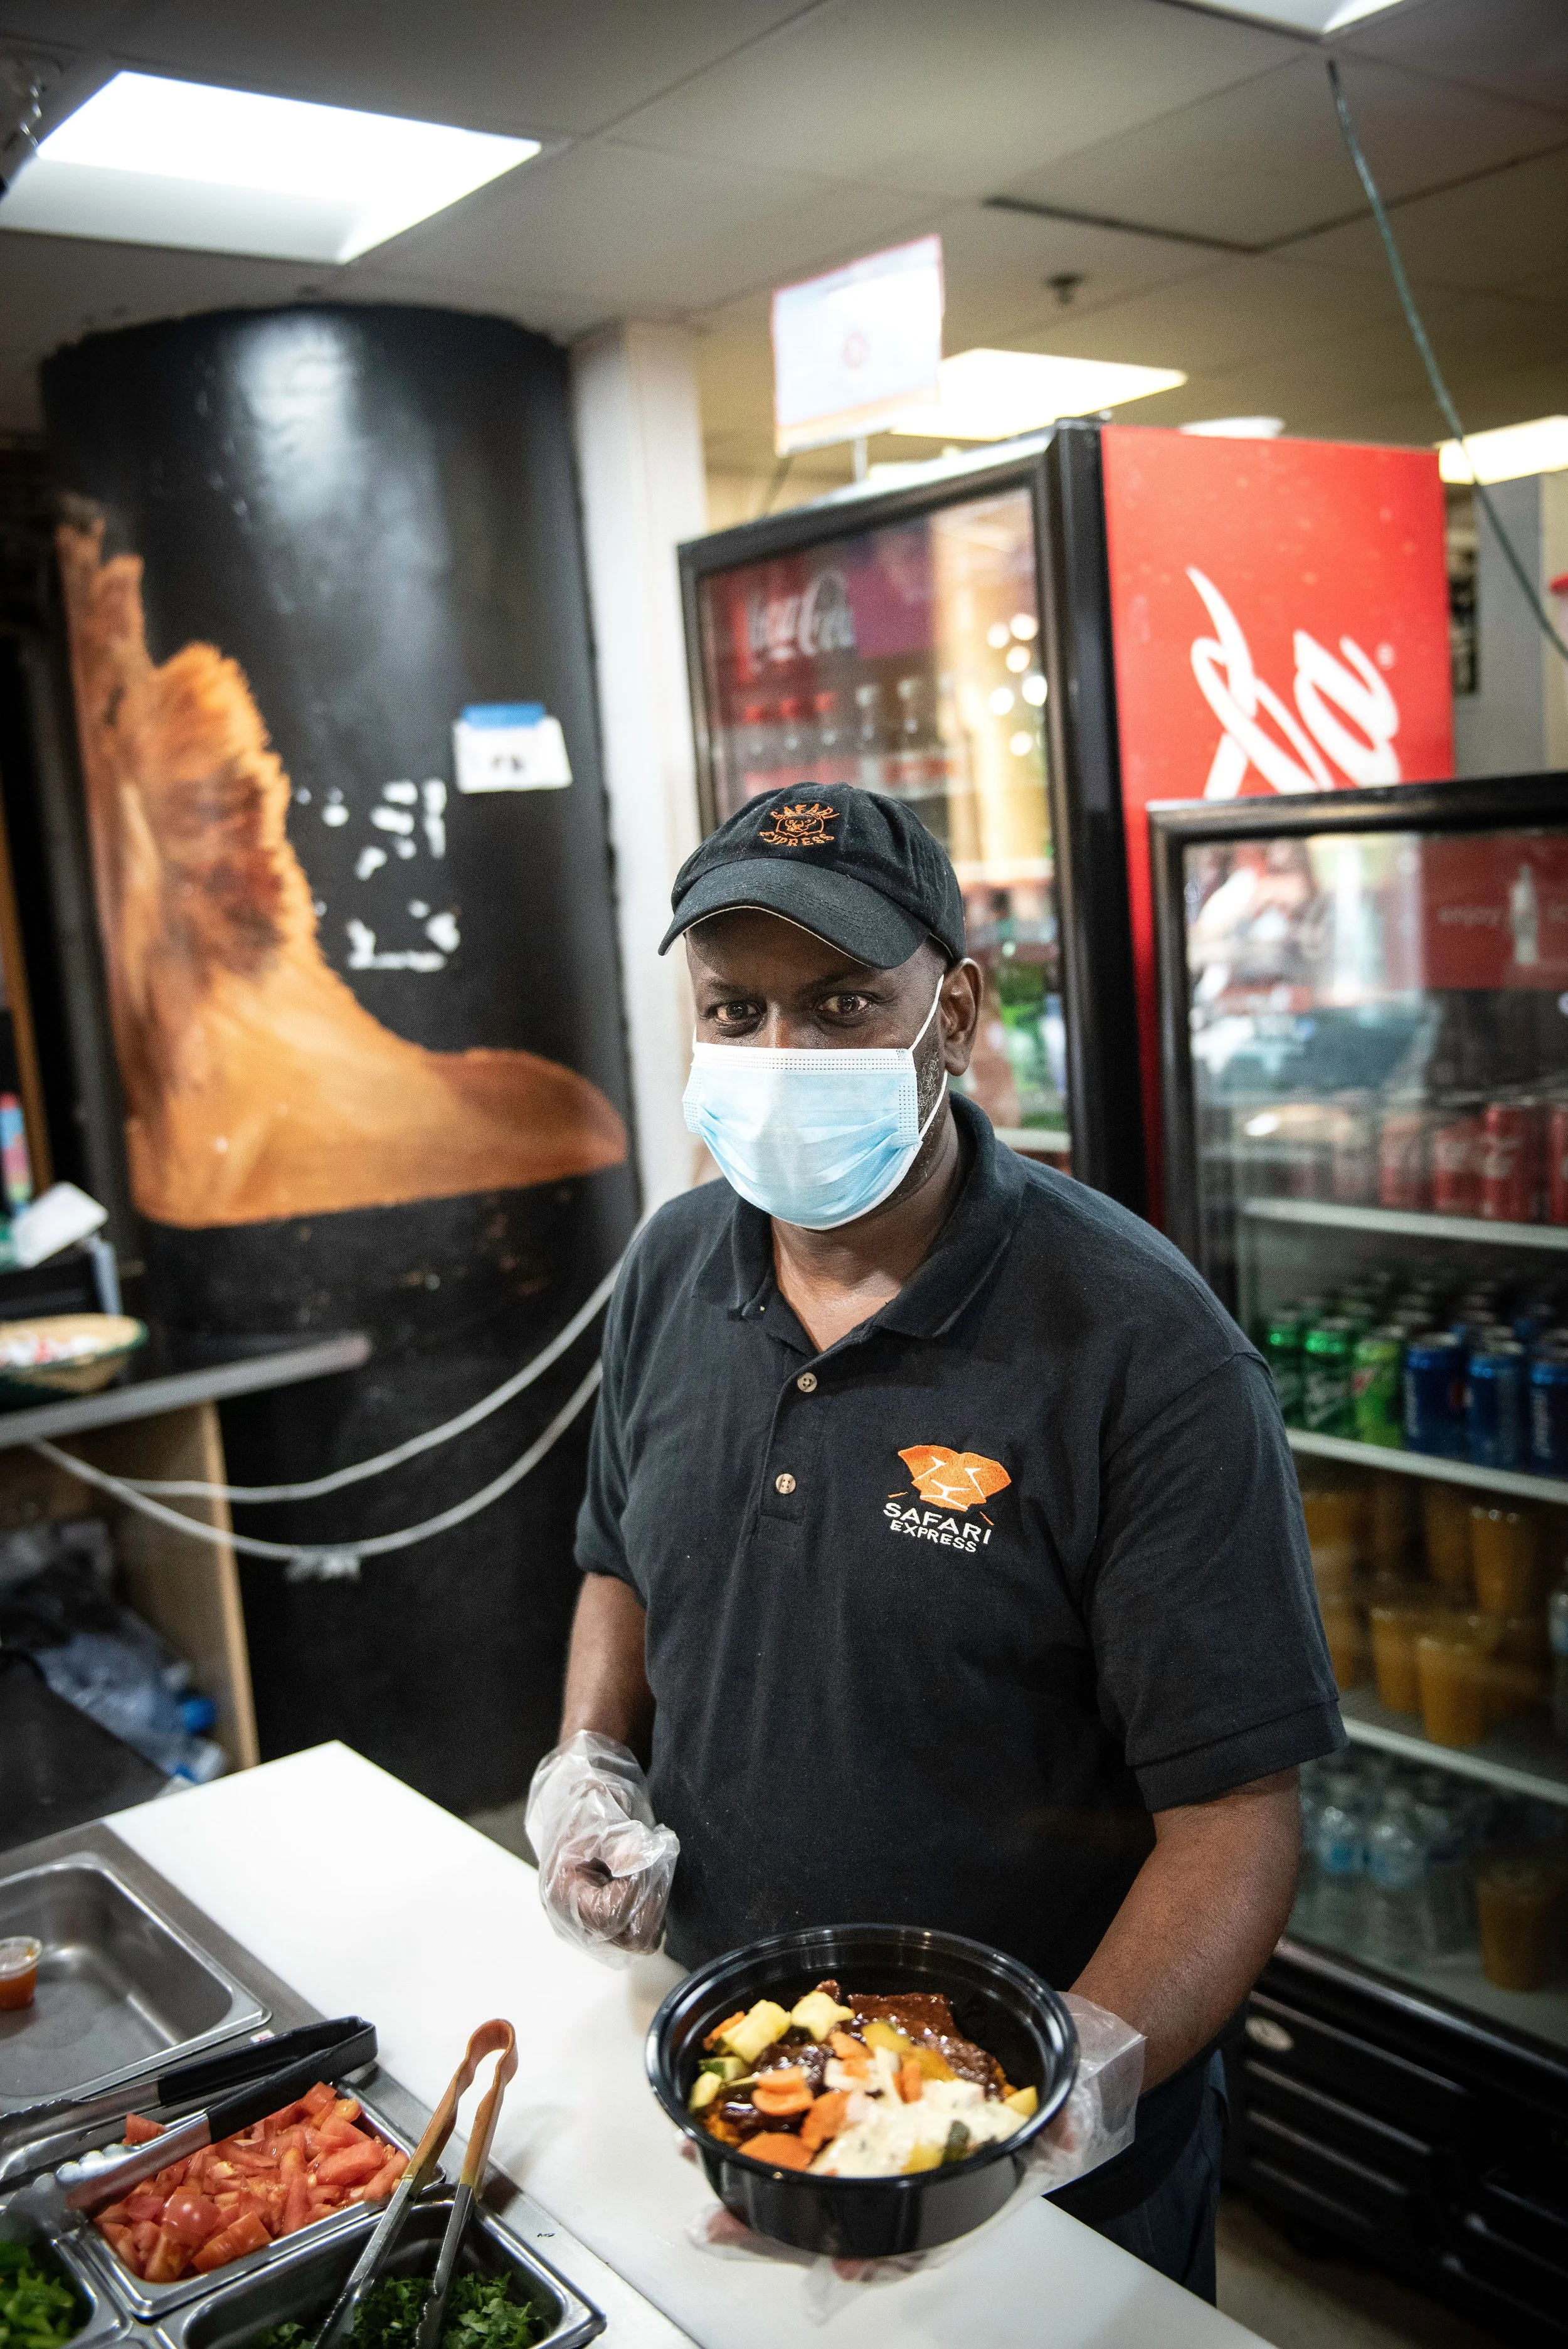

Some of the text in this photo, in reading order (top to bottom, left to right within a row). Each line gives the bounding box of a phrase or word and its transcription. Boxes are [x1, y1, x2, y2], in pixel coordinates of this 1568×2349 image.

[770, 803, 840, 820] SAFARI
[883, 1502, 992, 1544] SAFARI
[889, 1520, 977, 1552] EXPRESS
